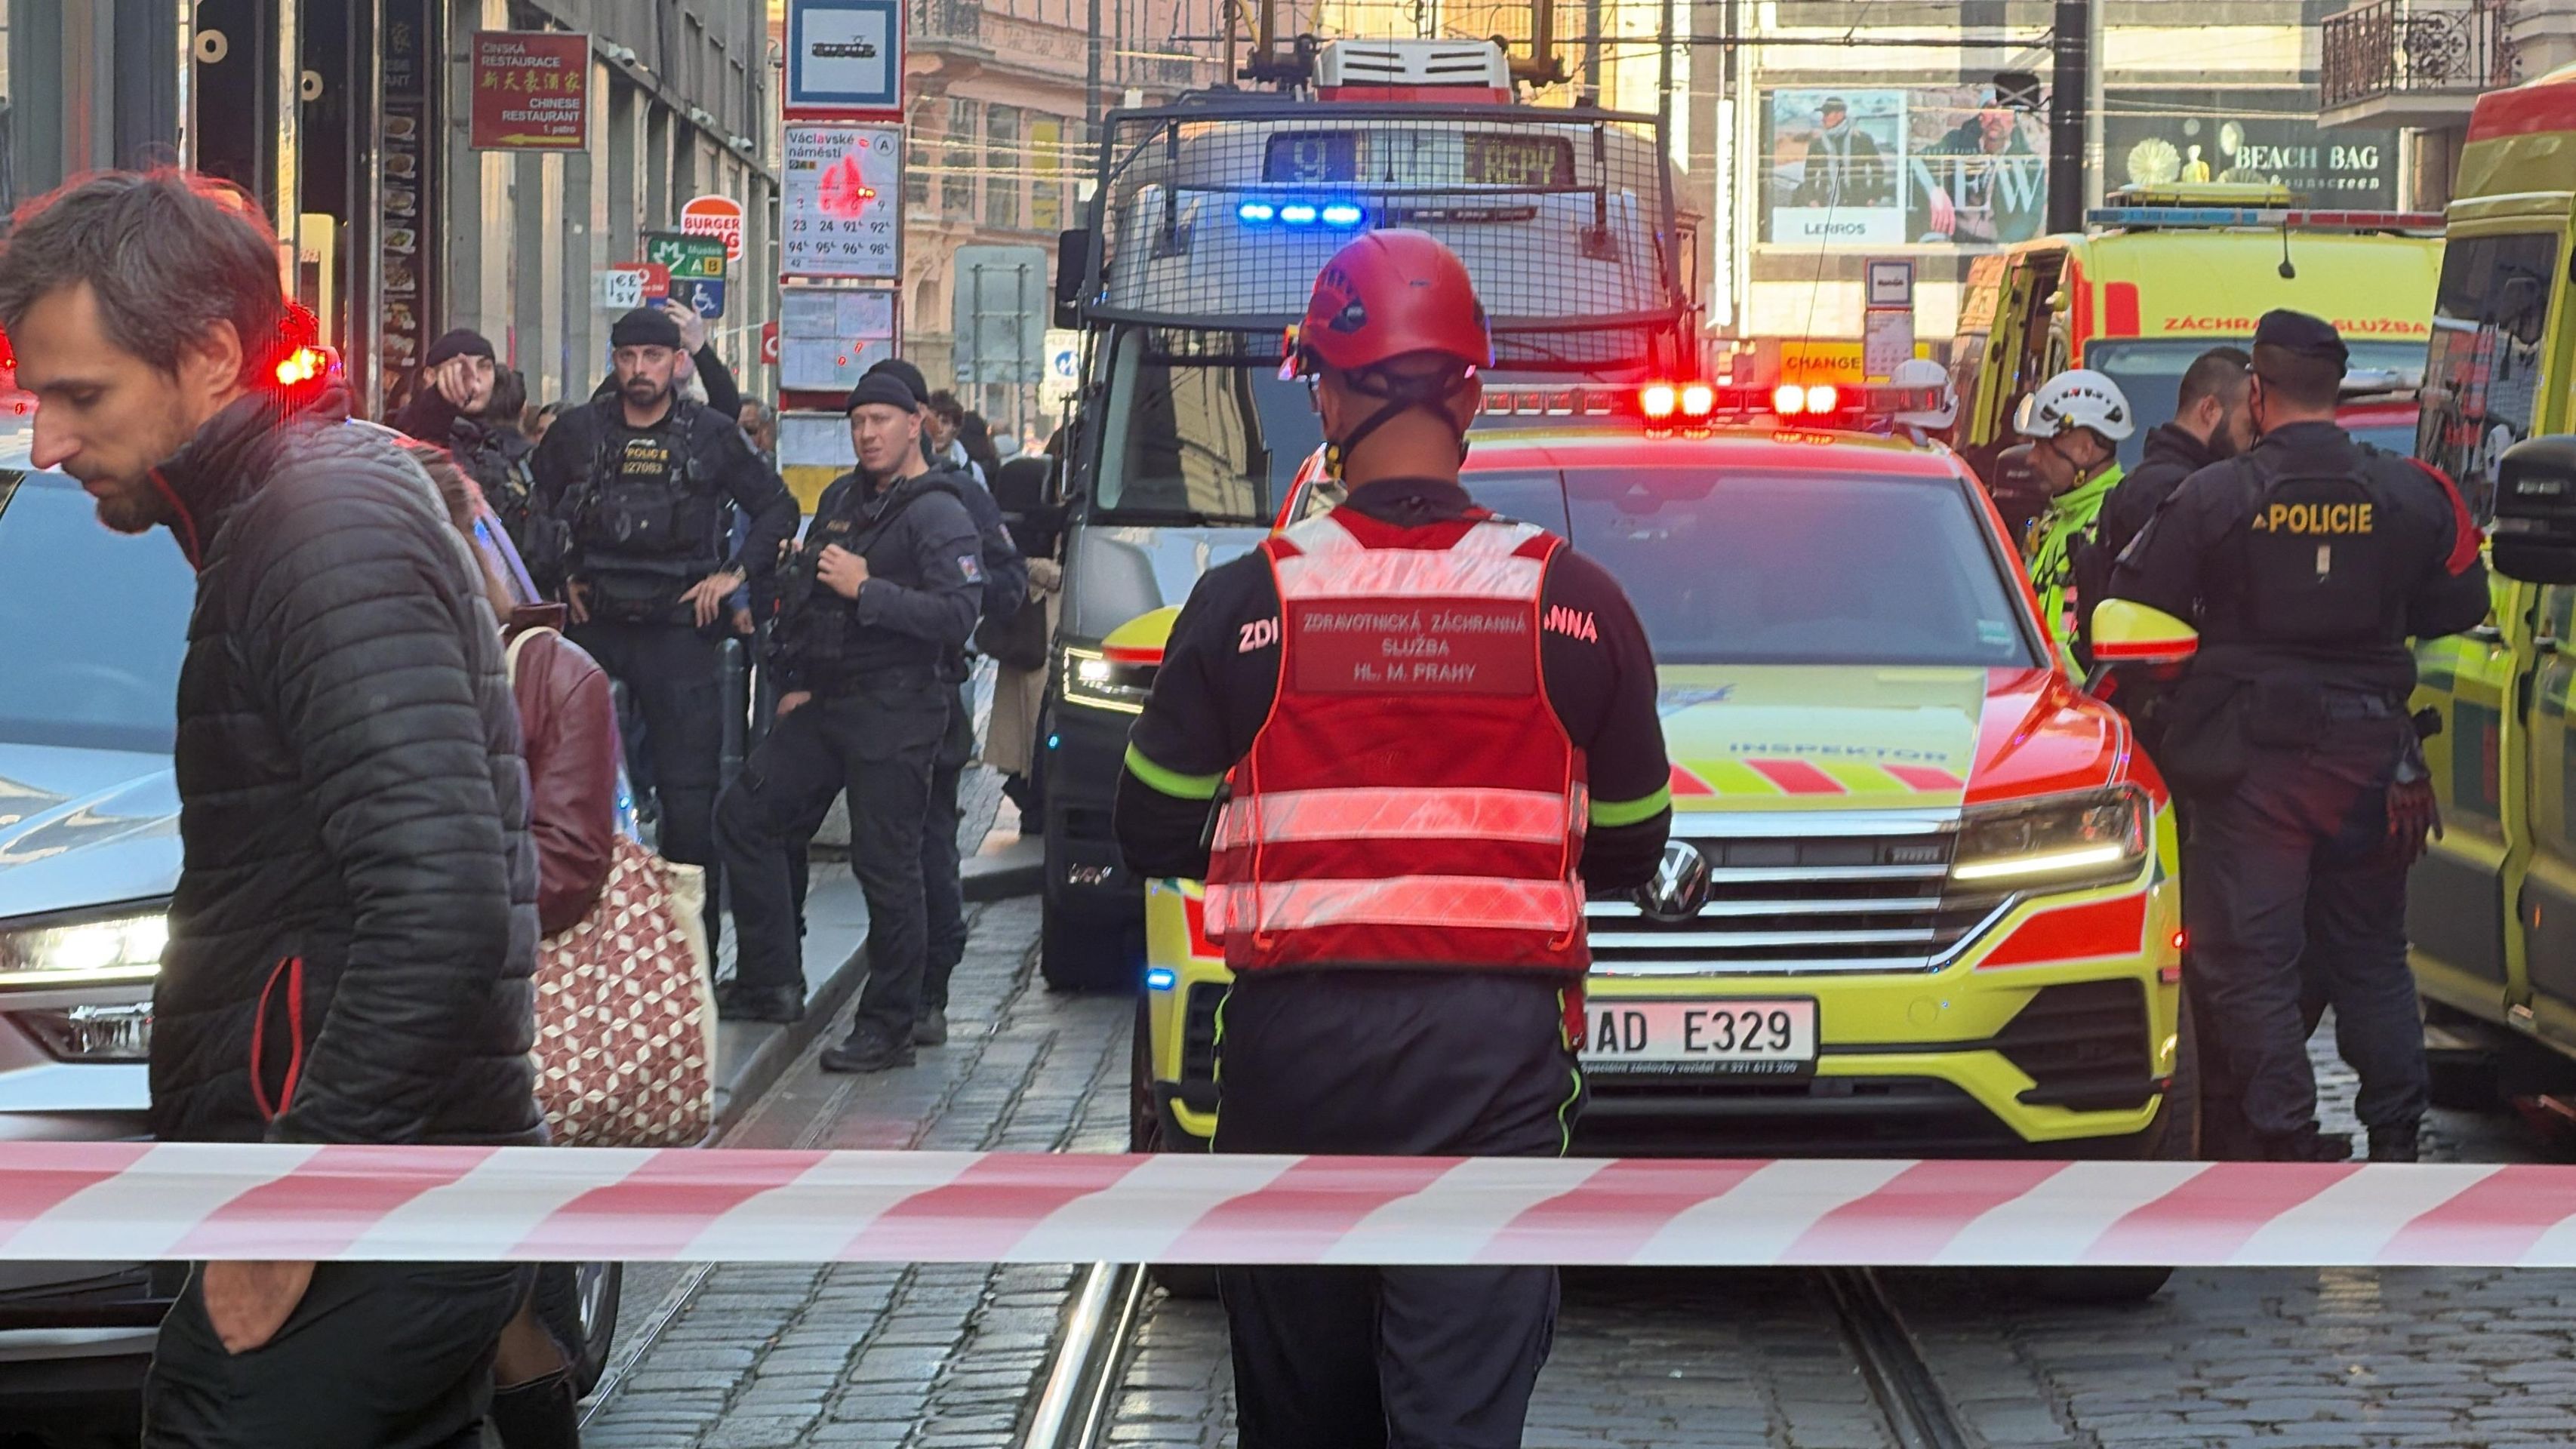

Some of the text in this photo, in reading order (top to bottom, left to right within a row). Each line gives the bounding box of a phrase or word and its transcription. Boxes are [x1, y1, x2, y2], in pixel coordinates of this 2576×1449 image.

[482, 42, 525, 54] ČINSKÁ
[482, 57, 561, 67] RESTAURACE
[529, 98, 580, 109] CHINESE
[502, 110, 580, 122] RESTAURANT
[552, 125, 577, 135] patro
[789, 133, 854, 145] Václavské
[789, 146, 842, 158] náměstí
[2235, 145, 2380, 170] BEACH BAG
[1293, 139, 1327, 183] 9
[1907, 156, 2044, 214] NEW
[878, 199, 886, 211] 9
[684, 217, 740, 229] BURGER
[792, 219, 808, 232] 23
[820, 220, 834, 232] 24
[1804, 223, 1867, 235] LERROS
[690, 258, 718, 272] A B
[2163, 314, 2429, 334] ZÁCHRA SLUŽBA
[1786, 355, 1861, 370] CHANGE
[2268, 503, 2374, 534] POLICIE
[1303, 608, 1527, 635] ZDRAVOTNICKÁ ZÁCHRANNÁ
[1238, 617, 1279, 654] ZD
[1381, 633, 1450, 657] SLUŽBA
[1353, 663, 1478, 683] HL. M. PRAHY
[1729, 743, 1948, 761] INSPEKTOR
[1684, 1011, 1792, 1054] E329
